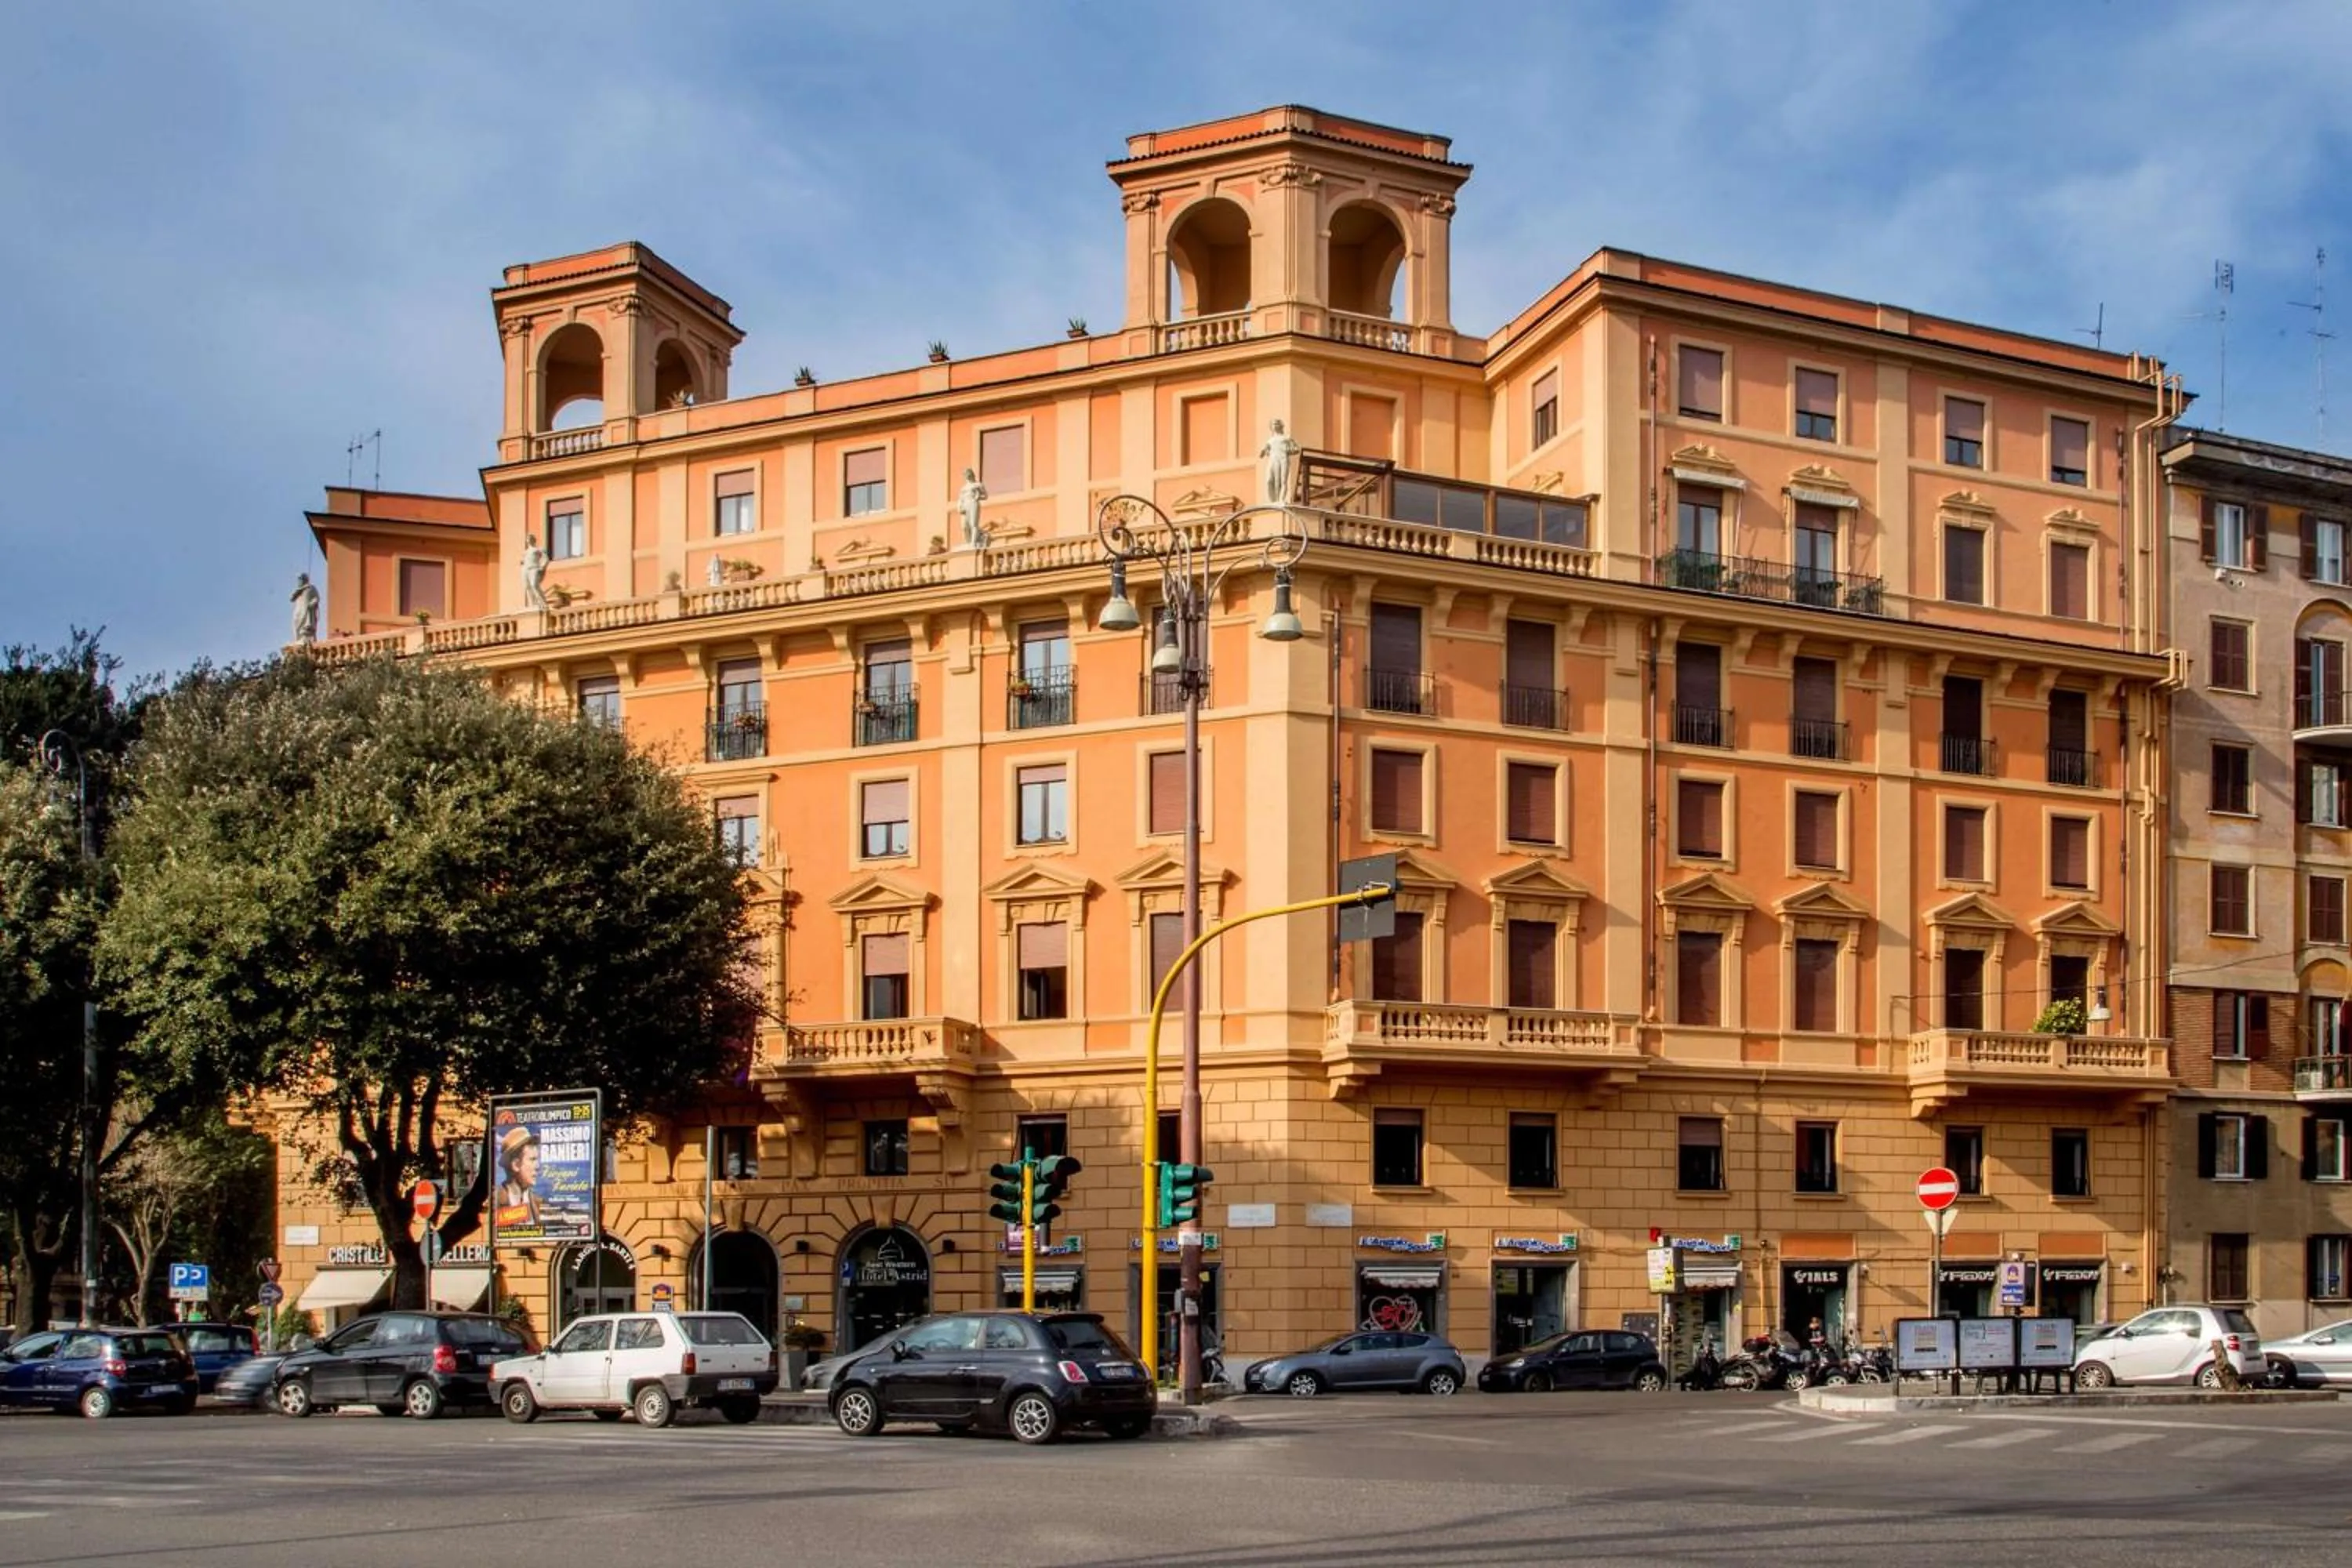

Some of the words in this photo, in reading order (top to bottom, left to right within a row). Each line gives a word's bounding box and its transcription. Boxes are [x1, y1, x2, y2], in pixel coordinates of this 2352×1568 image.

[540, 1126, 590, 1143] MASSIMO
[540, 1142, 590, 1162] RANIERI
[174, 1266, 187, 1286] P
[888, 1268, 928, 1281] Astrid
